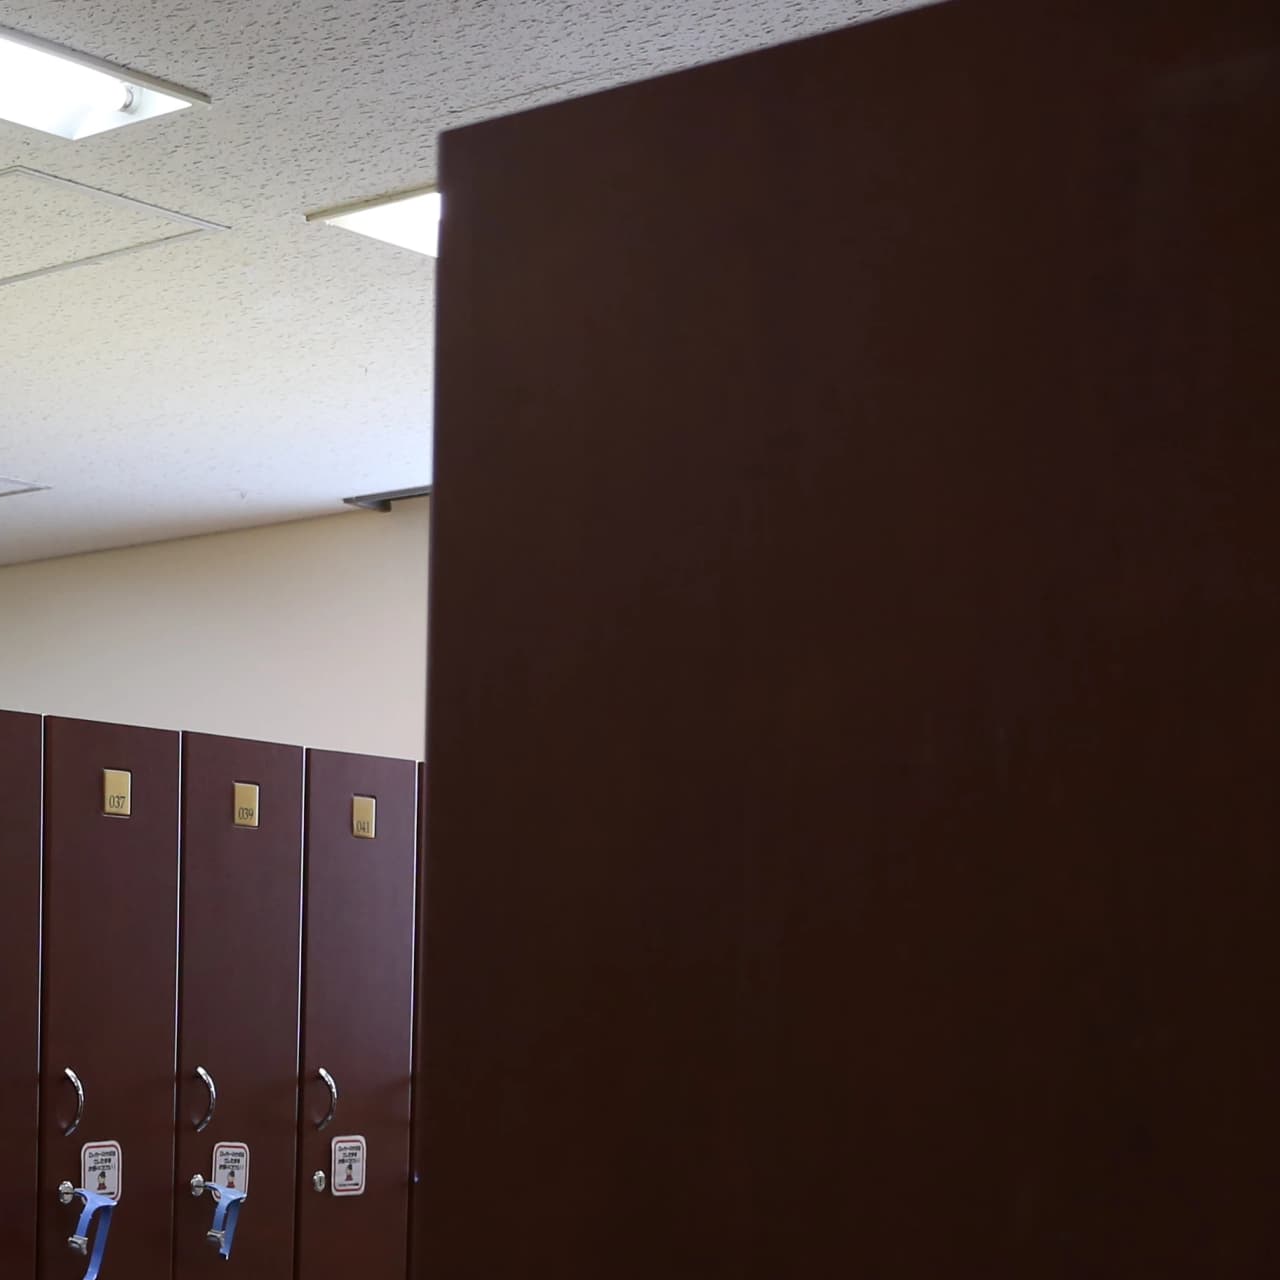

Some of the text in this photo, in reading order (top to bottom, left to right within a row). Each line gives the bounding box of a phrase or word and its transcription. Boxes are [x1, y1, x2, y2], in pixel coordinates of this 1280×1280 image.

[109, 795, 126, 808] 037
[238, 808, 254, 820] 039
[356, 821, 370, 834] 041
